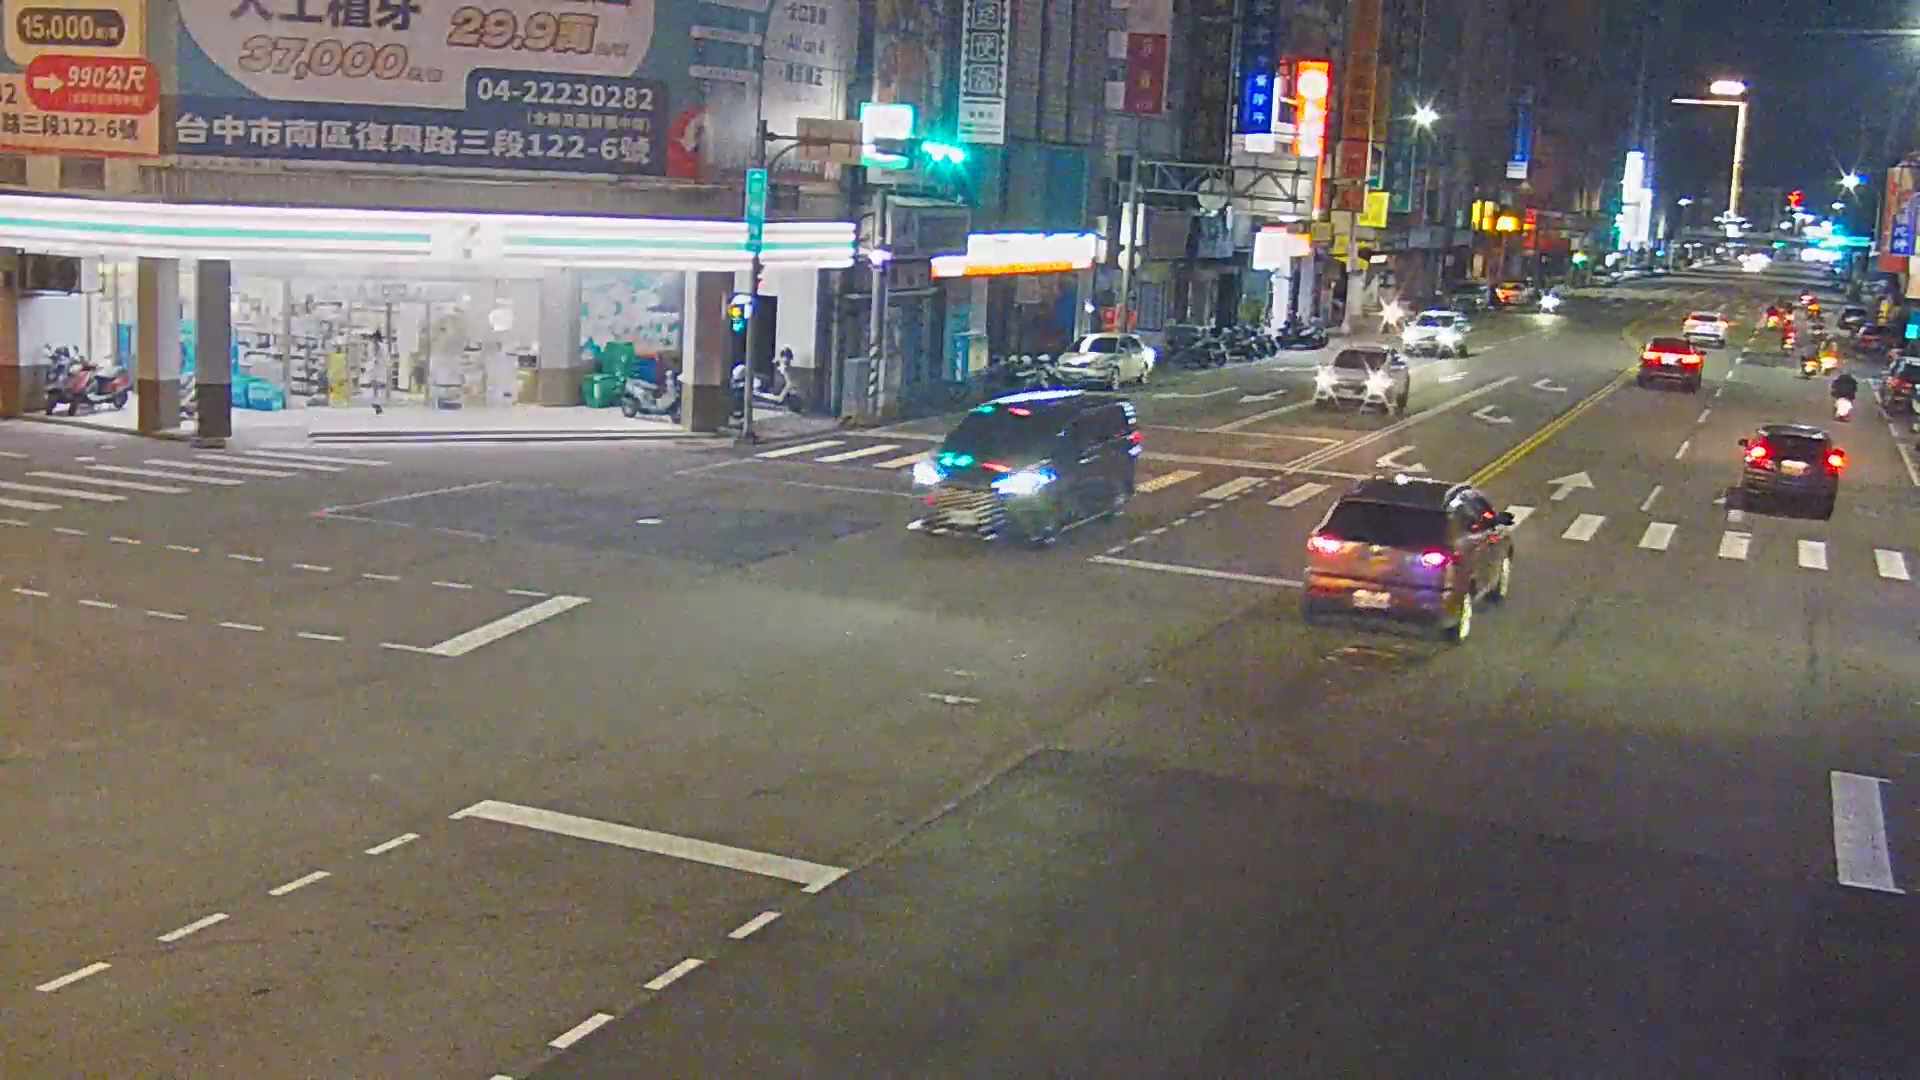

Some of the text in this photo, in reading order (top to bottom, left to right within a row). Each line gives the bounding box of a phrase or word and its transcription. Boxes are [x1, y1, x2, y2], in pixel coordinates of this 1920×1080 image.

[238, 34, 409, 80] 37,000
[67, 65, 147, 92] 990公尺
[477, 77, 653, 111] 04-22230282
[175, 113, 650, 164] 台中市南區復興路三段122-6號
